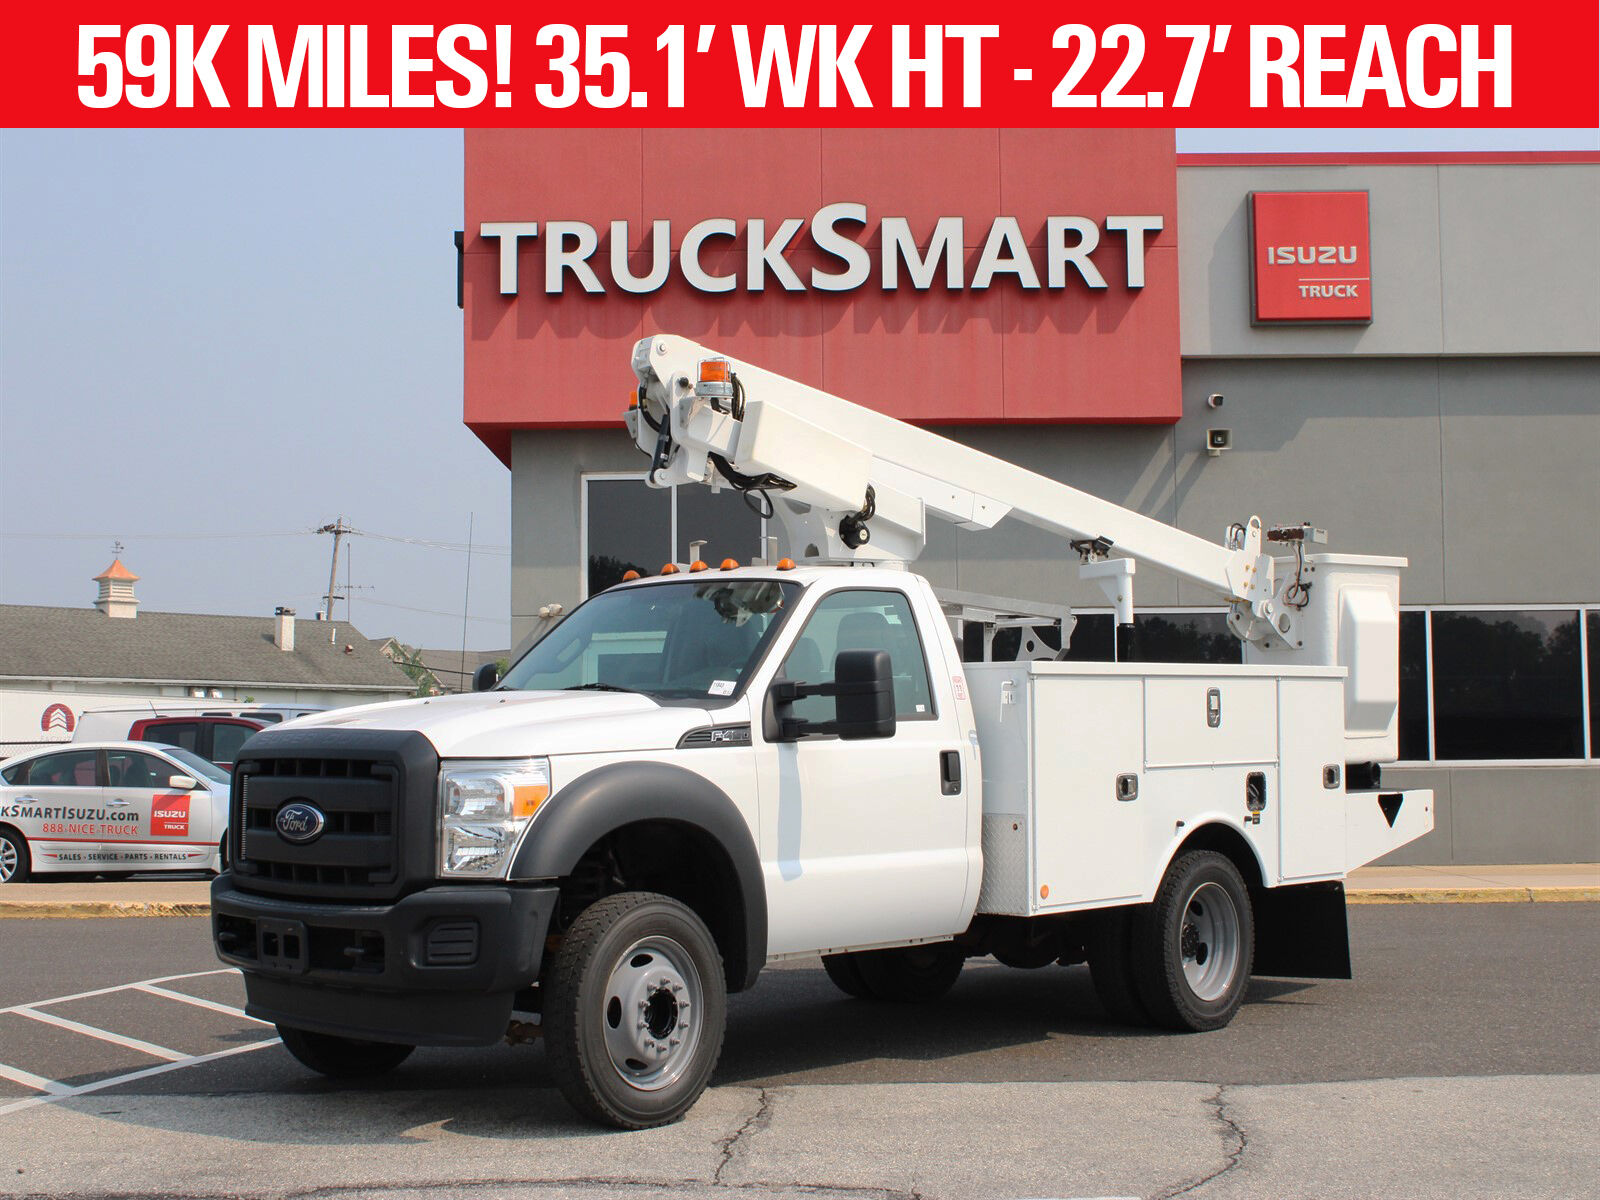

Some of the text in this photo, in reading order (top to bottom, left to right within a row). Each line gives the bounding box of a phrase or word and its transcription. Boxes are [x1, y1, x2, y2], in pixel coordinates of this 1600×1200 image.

[1267, 245, 1357, 265] ISUZU
[1298, 285, 1359, 298] TRUCK
[154, 810, 187, 819] ISUZU
[280, 809, 309, 832] Ford
[58, 853, 187, 861] SALES SERVICE PARTS RENTALS
